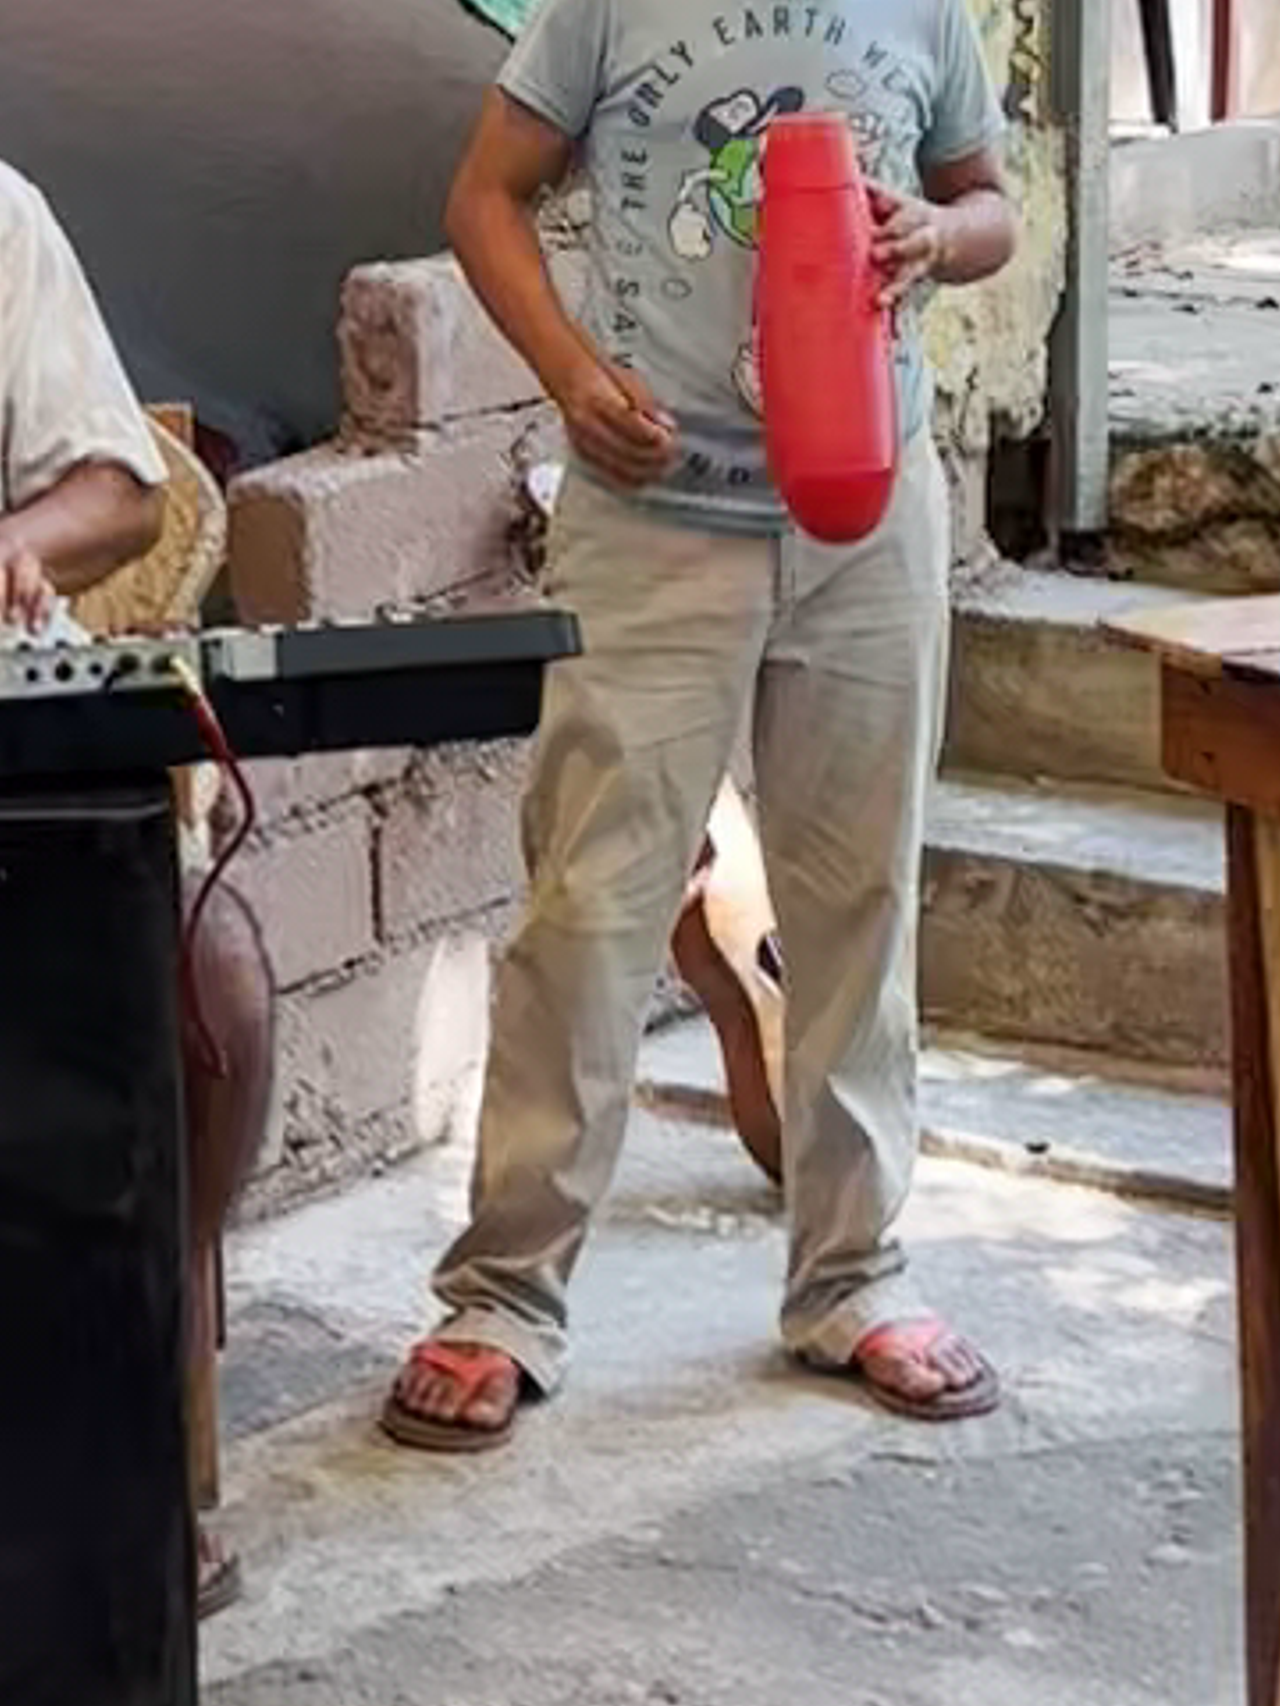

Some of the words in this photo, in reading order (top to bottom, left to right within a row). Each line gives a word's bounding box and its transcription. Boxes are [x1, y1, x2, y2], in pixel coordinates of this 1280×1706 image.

[712, 5, 847, 47] EARTH
[627, 39, 694, 129] ONLY
[620, 147, 649, 211] THE
